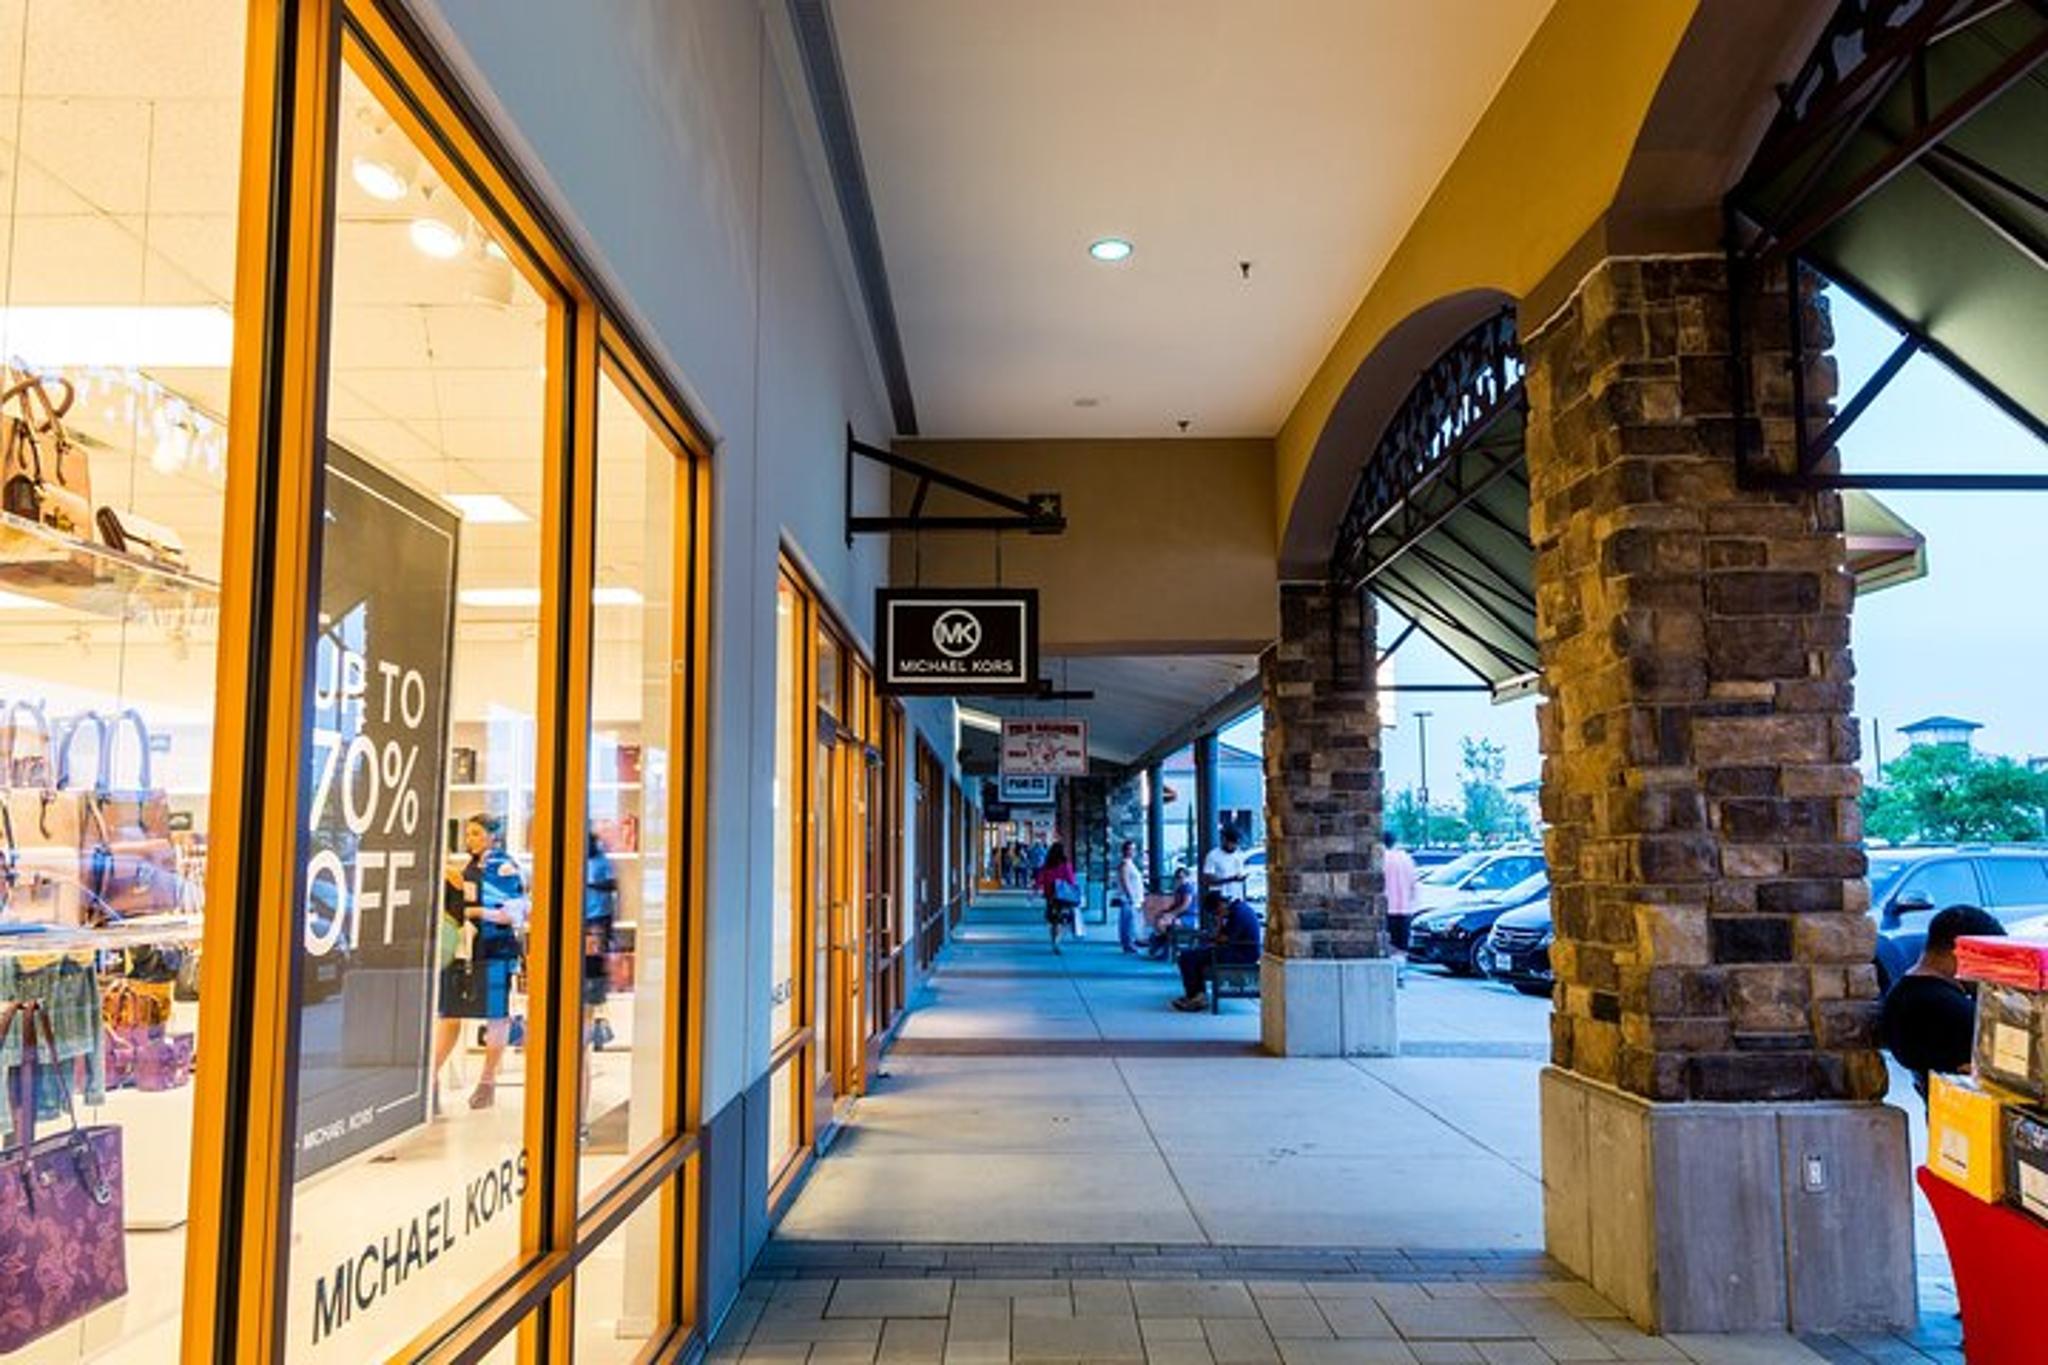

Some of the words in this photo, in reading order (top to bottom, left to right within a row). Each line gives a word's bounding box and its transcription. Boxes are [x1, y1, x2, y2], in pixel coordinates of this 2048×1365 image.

[315, 635, 365, 715] UP
[378, 660, 426, 729] TO
[899, 659, 967, 673] MICHAEL
[972, 659, 1014, 673] KORS
[934, 619, 981, 648] MK
[310, 728, 419, 836] 70%
[304, 849, 415, 957] OFF
[312, 1196, 456, 1346] MICHAEL
[464, 1147, 530, 1236] KORS
